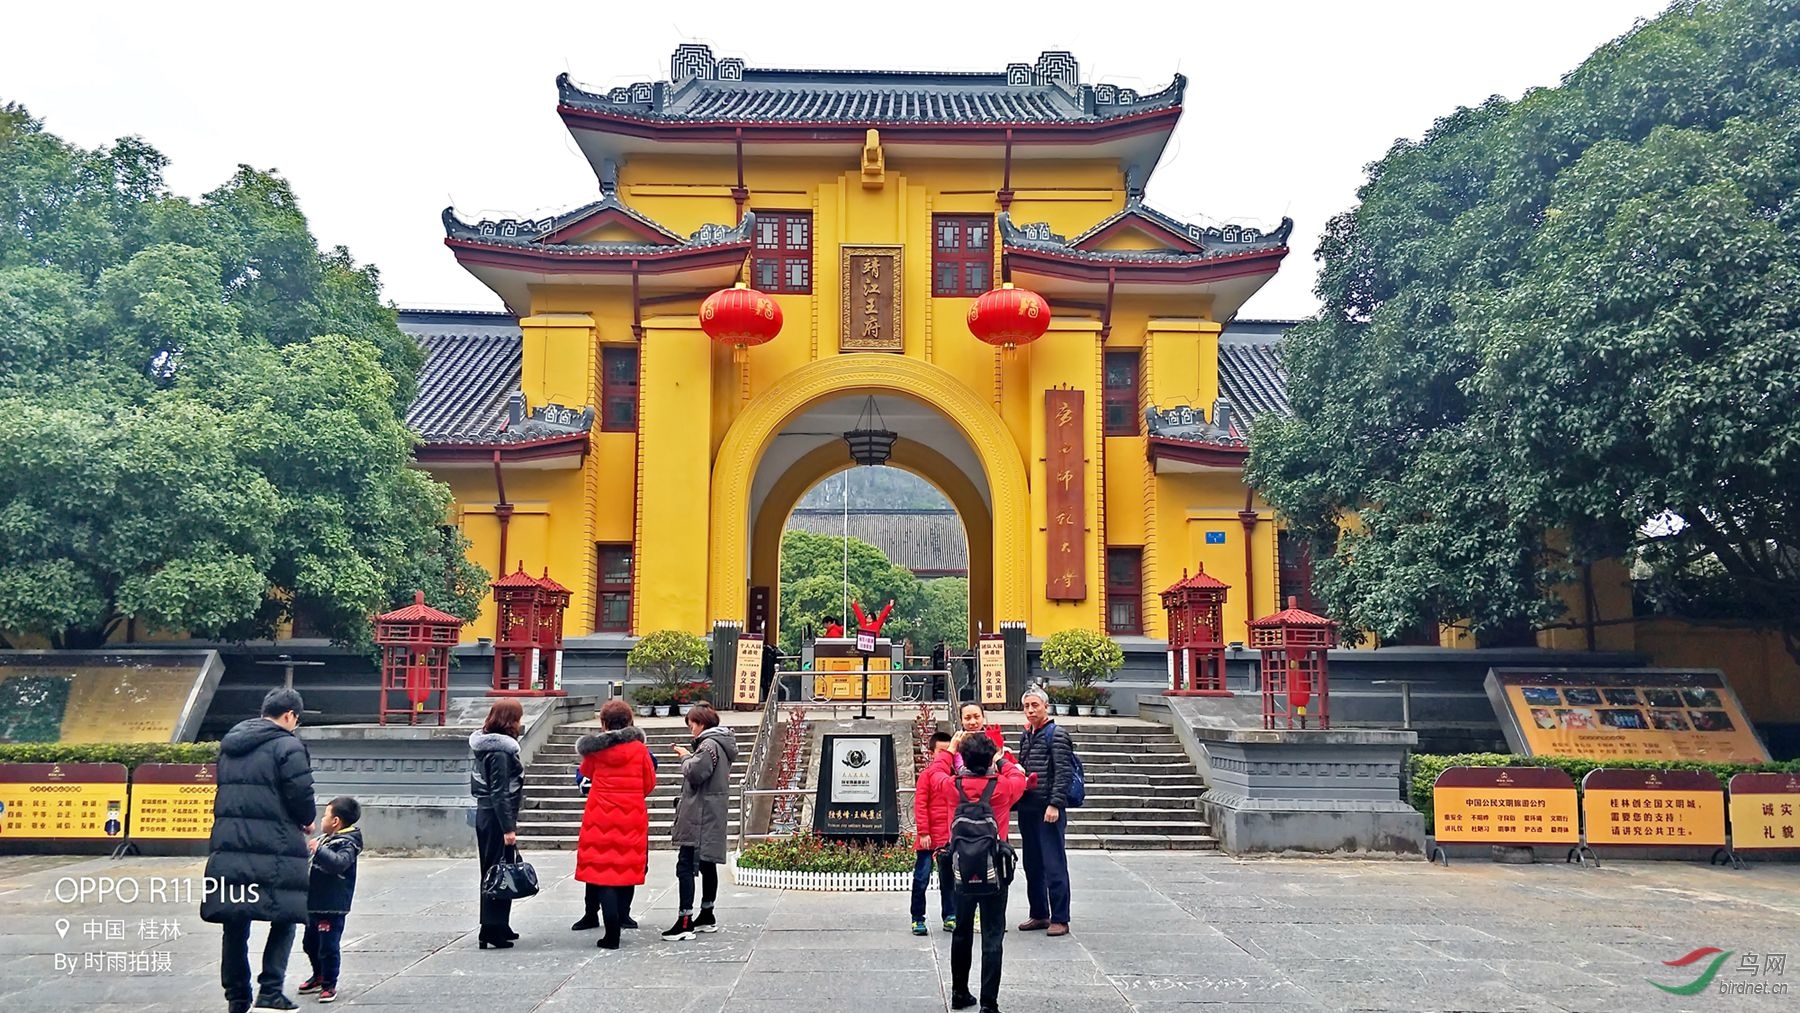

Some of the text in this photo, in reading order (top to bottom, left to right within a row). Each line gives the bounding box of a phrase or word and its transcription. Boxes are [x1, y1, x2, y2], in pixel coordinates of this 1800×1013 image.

[862, 256, 881, 339] 靖江王府
[1466, 798, 1546, 808] 中国公民文明旅游公约
